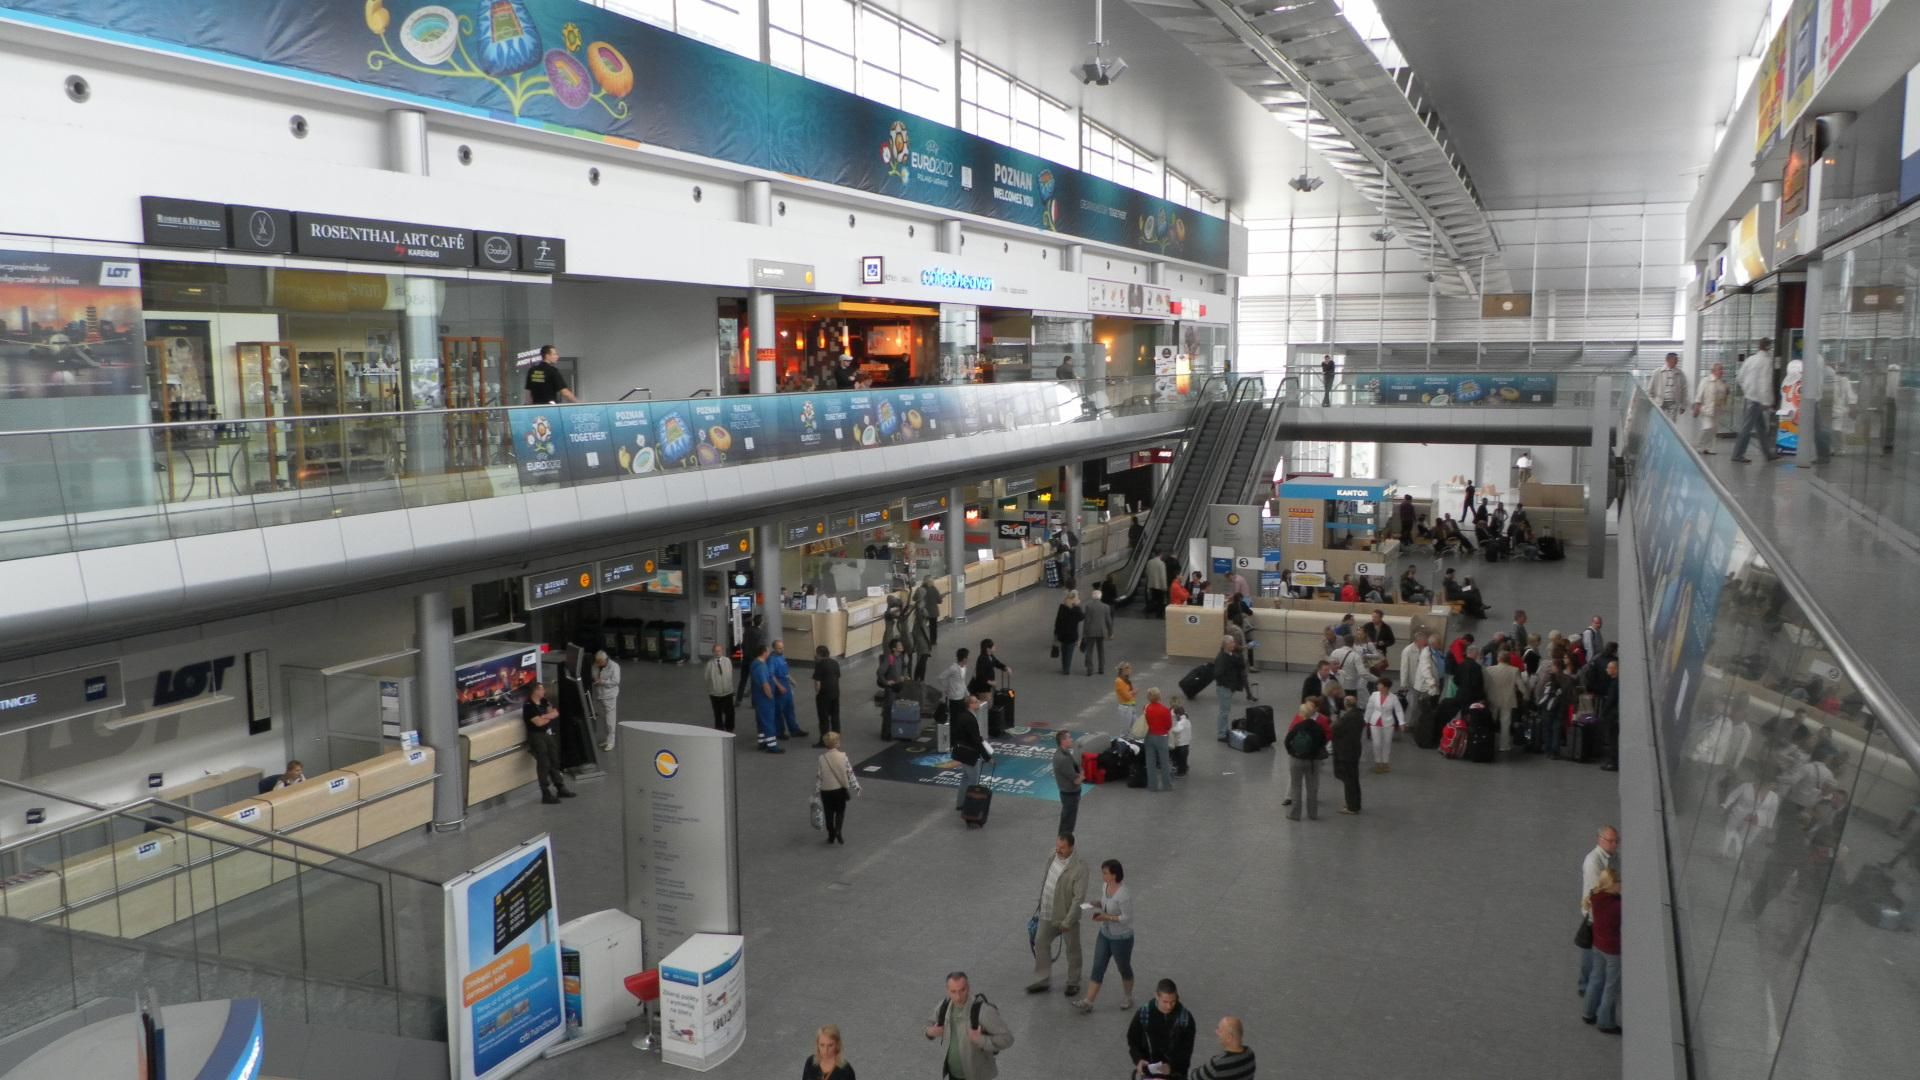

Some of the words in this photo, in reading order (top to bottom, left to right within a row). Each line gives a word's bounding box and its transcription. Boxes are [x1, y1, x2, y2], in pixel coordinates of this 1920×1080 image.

[995, 163, 1033, 191] POZNAN
[993, 186, 1023, 205] WELCOMES
[1022, 195, 1034, 207] YOU
[310, 223, 400, 244] ROSENTHAL
[401, 232, 428, 247] ART
[430, 233, 465, 250] CAFÉ
[106, 267, 132, 279] LOT
[569, 431, 608, 442] TOGETHER
[1336, 488, 1370, 498] KANTOR
[153, 655, 236, 707] LOT
[331, 778, 345, 789] LOT
[240, 807, 256, 819] LOT
[139, 842, 157, 854] LOT
